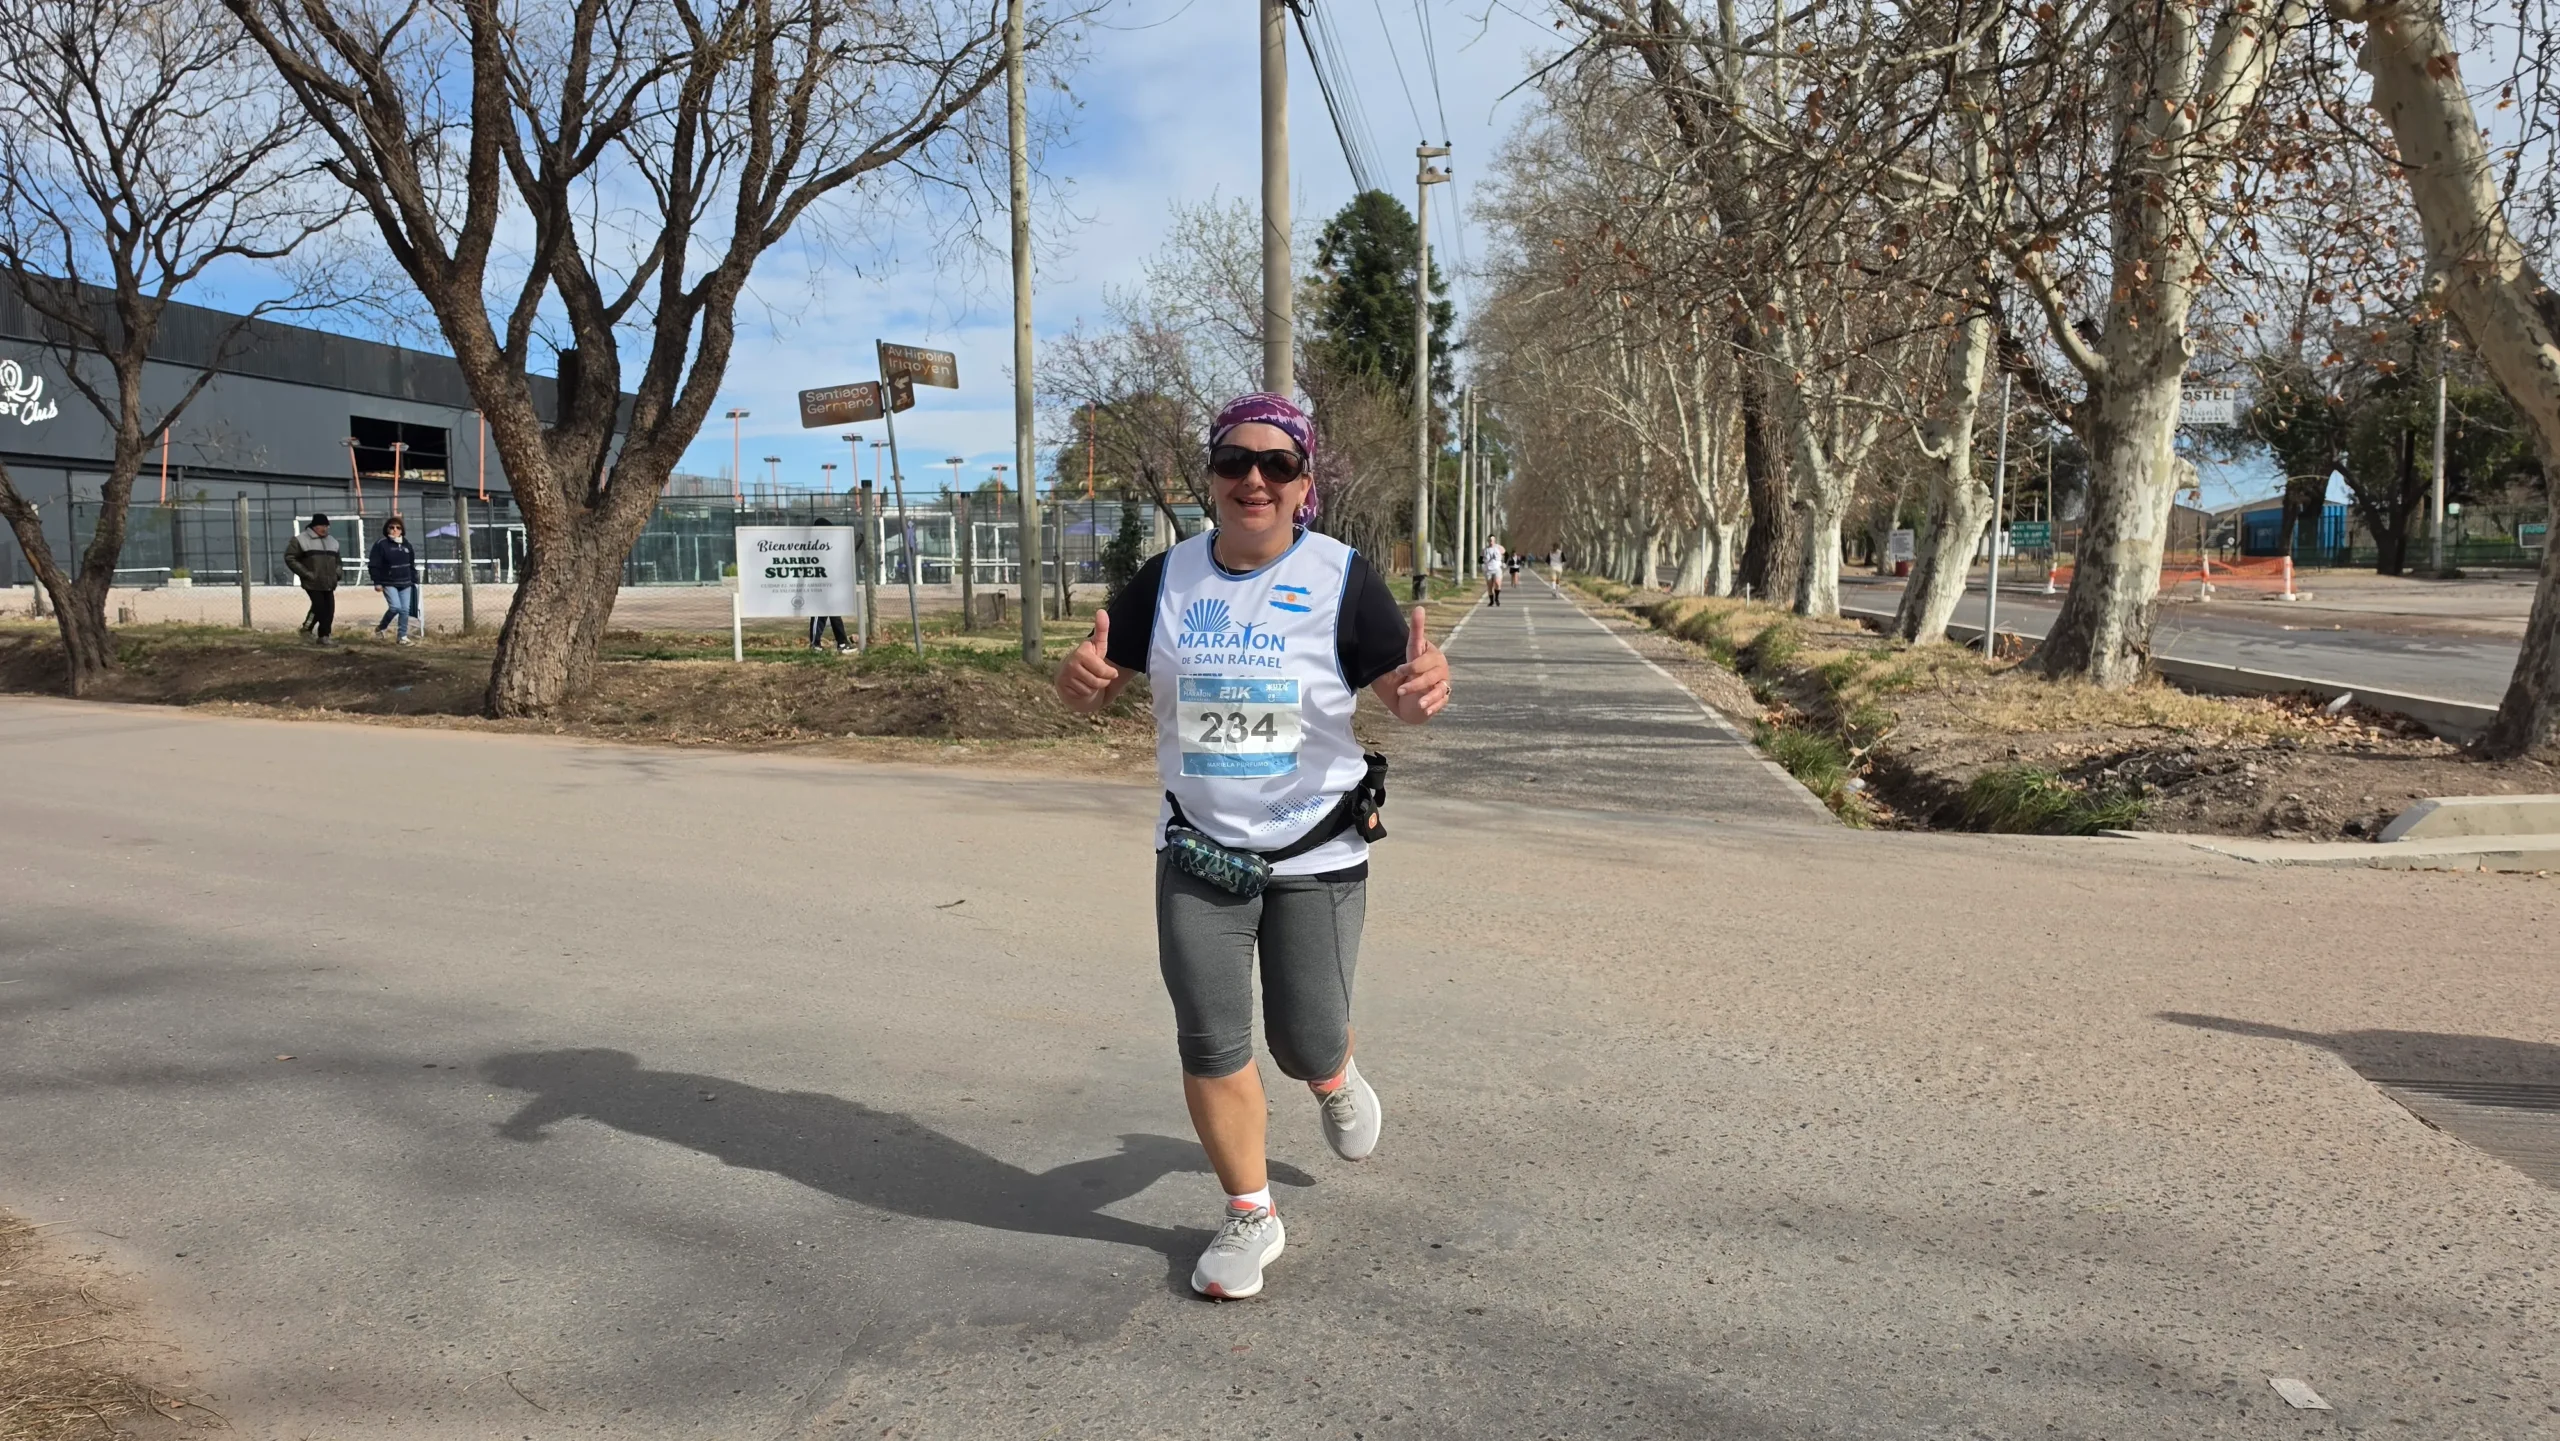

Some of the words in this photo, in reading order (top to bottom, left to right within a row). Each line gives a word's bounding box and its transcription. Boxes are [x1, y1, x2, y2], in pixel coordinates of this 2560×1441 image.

[888, 346, 902, 357] Av
[905, 349, 953, 364] Hipolito
[805, 386, 869, 403] Santiago
[2182, 390, 2232, 401] OSTEL
[21, 398, 59, 426] Club
[807, 394, 874, 415] Germanó
[757, 539, 833, 553] Bienvenidos
[772, 556, 820, 565] BARRIO
[765, 566, 828, 579] SUTER
[1181, 657, 1191, 665] DE
[1194, 653, 1225, 665] SAN
[1228, 653, 1283, 669] RAFAEL
[1219, 686, 1253, 700] 21K
[1199, 711, 1278, 743] 234
